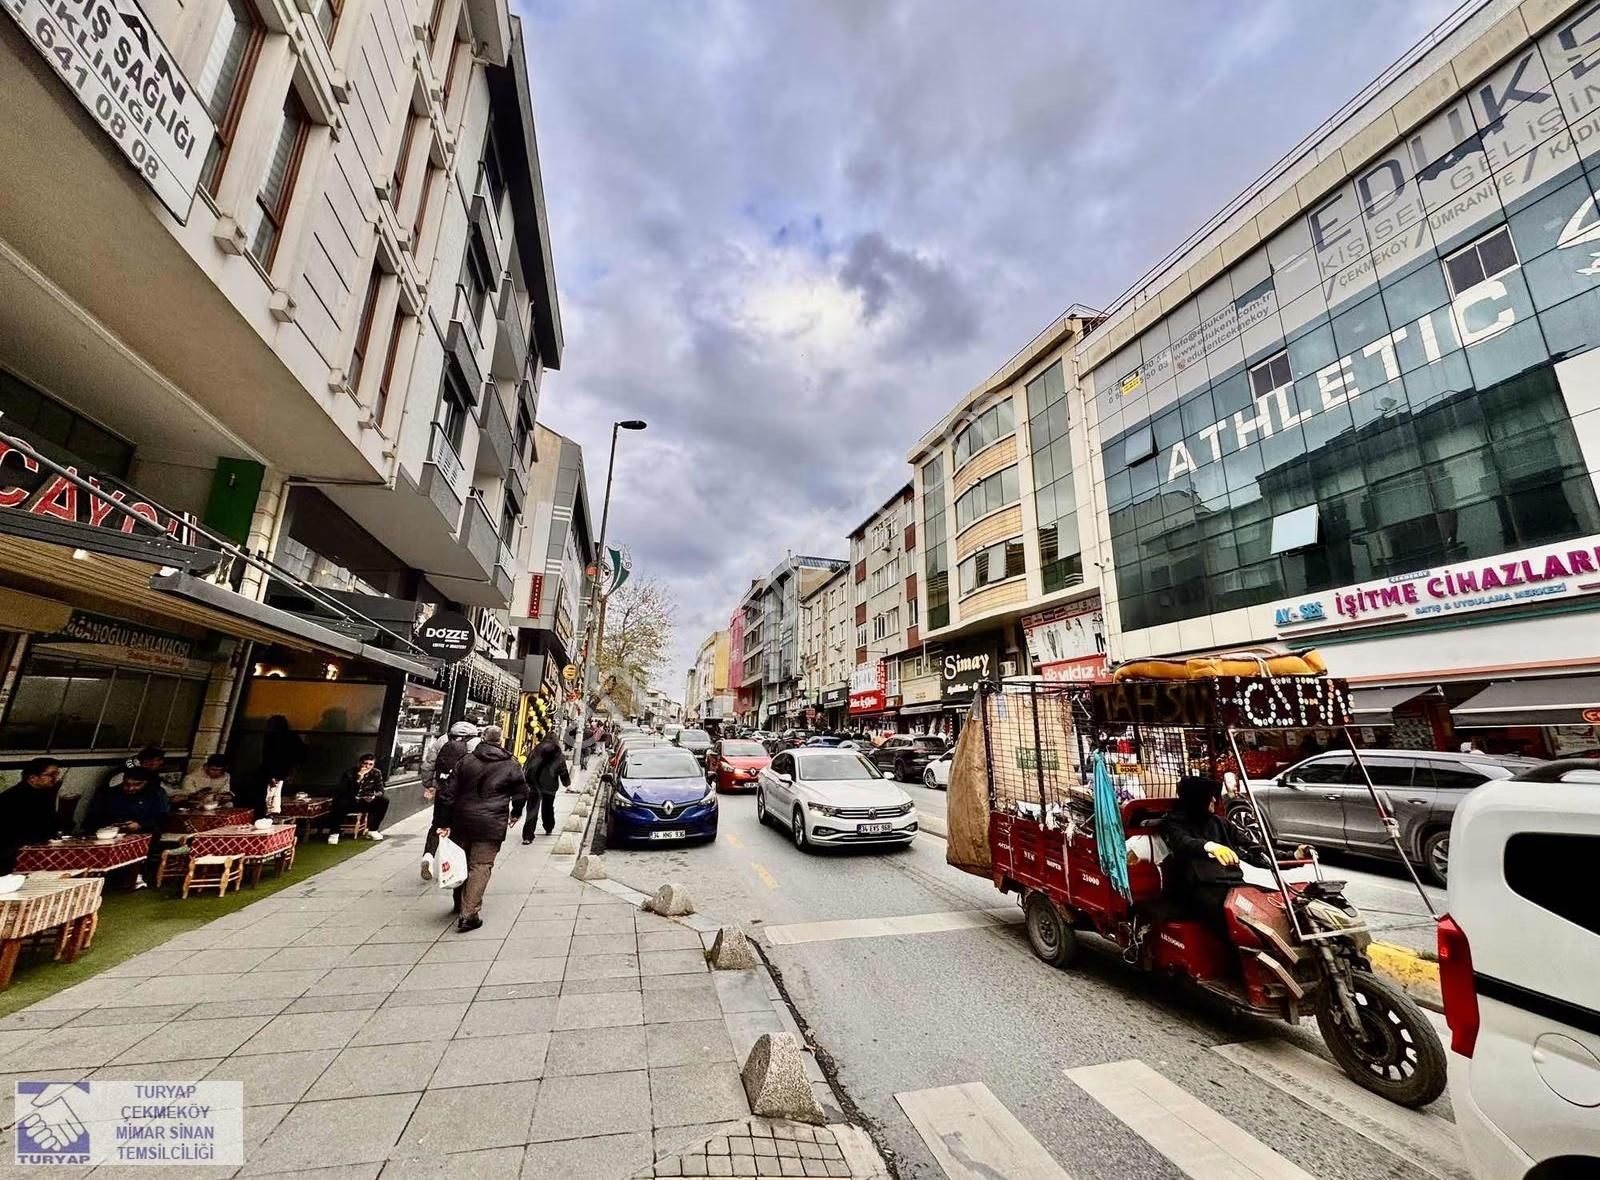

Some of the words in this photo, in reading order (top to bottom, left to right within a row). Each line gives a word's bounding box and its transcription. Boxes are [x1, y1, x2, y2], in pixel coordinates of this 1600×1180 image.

[35, 17, 89, 91] 641
[95, 93, 127, 139] 08
[131, 139, 160, 180] 08
[47, 0, 153, 134] KLİNİĞİ
[108, 0, 186, 105] AN
[113, 36, 196, 160] SAĞLIĞI
[1167, 279, 1516, 484] ATHLETIC
[1334, 582, 1419, 618] İŞİTME
[1454, 592, 1513, 609] UYGULAMA
[944, 653, 989, 680] Simay
